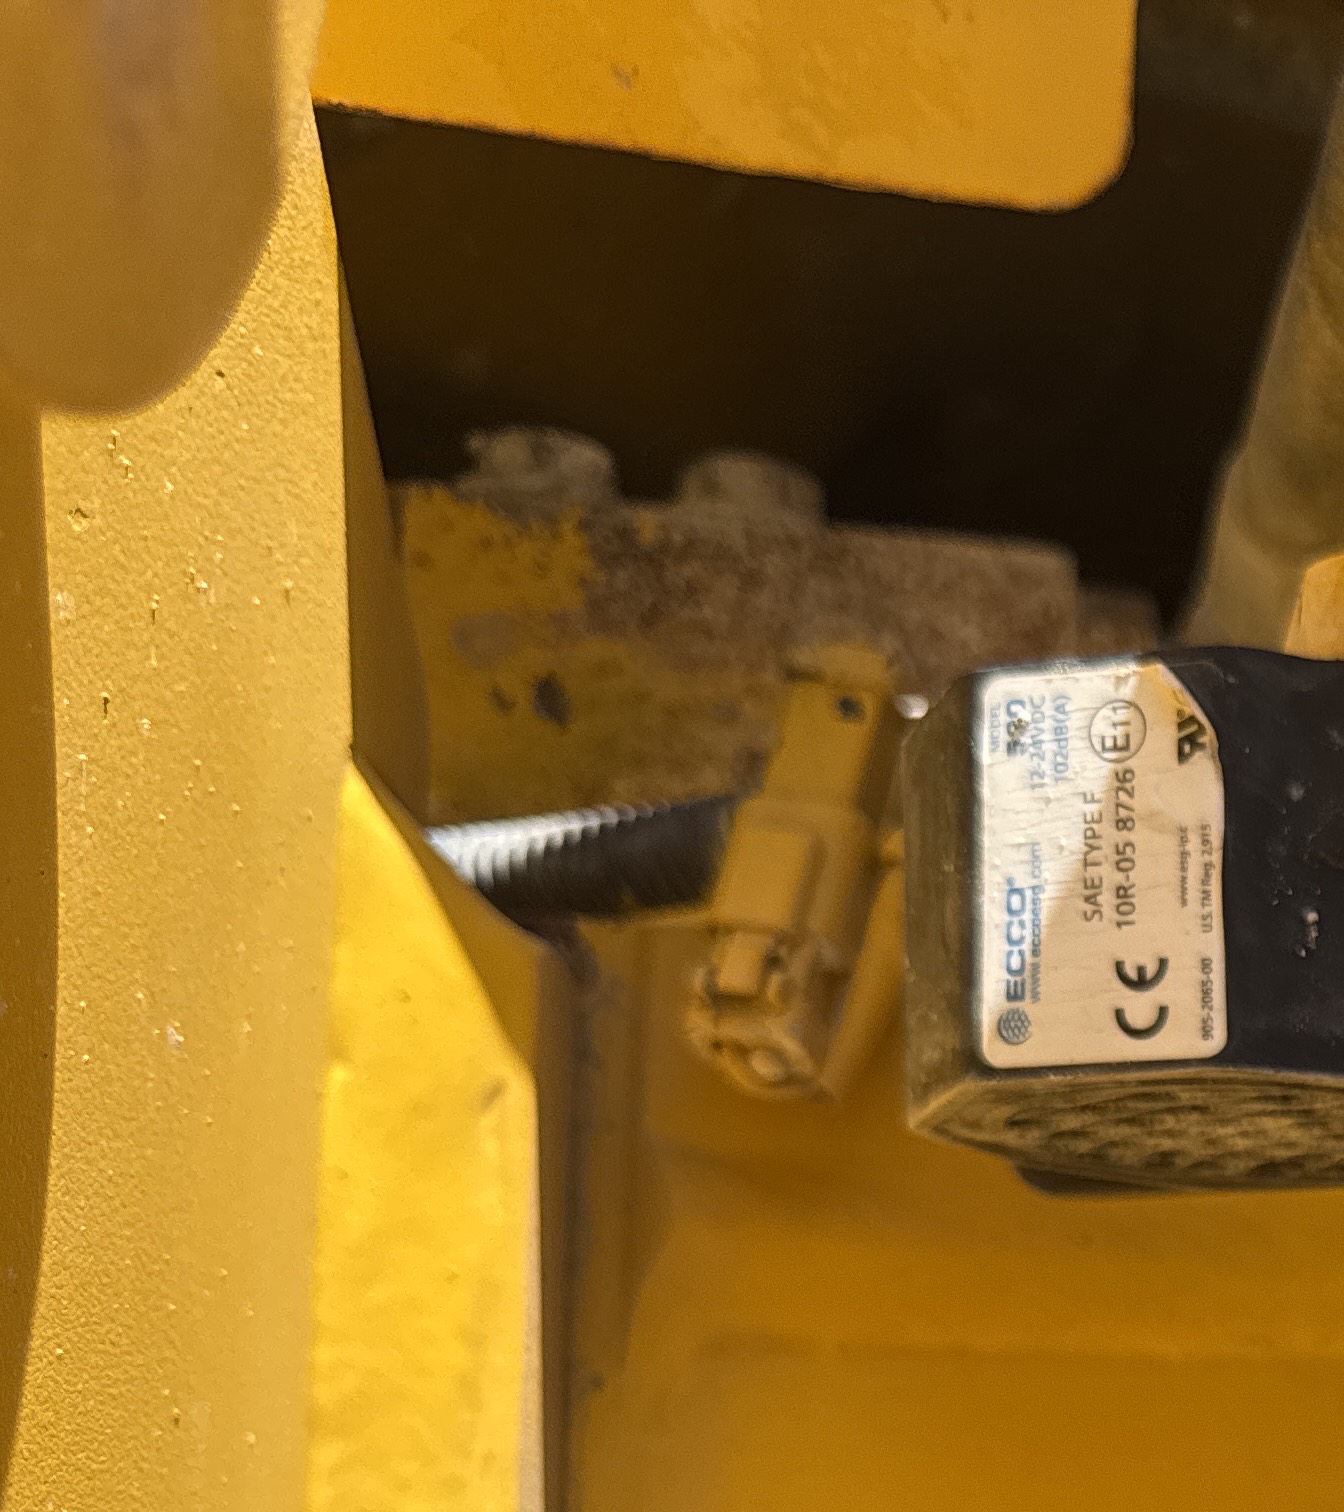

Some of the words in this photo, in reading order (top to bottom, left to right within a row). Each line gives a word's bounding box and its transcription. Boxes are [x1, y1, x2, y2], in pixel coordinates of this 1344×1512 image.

[990, 702, 1001, 753] MODEL
[1053, 694, 1070, 784] 102dB(A)
[1083, 792, 1103, 804] F
[1114, 767, 1136, 832] 8726
[1083, 809, 1103, 872] TYPE
[1084, 876, 1103, 922] SAE
[1115, 842, 1136, 930] 10R-05
[1201, 889, 1212, 909] TM
[1006, 887, 1026, 1002] ECCO
[1115, 957, 1169, 1040] CE
[1201, 957, 1213, 1041] 905-2065-00
